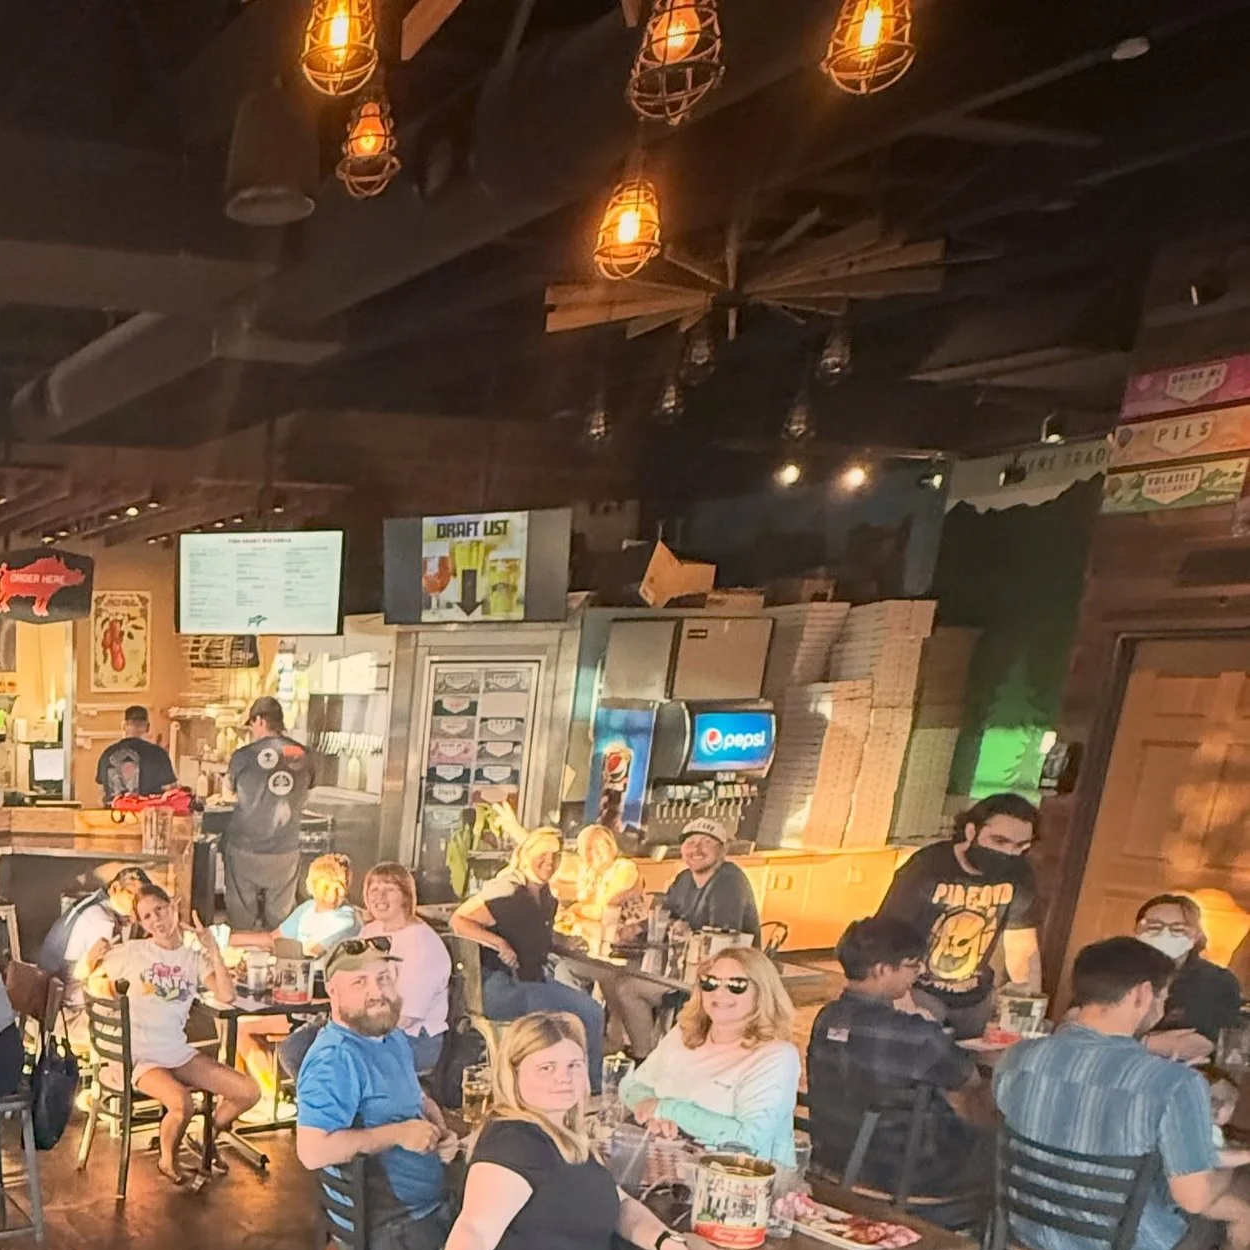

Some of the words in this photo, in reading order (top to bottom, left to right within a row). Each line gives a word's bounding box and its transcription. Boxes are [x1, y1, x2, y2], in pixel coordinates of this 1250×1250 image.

[1157, 421, 1210, 442] PILS
[437, 521, 480, 538] DRAFT
[483, 520, 510, 536] LIST
[10, 574, 40, 583] ORDER
[41, 574, 67, 584] HERE
[723, 731, 766, 751] pepsi
